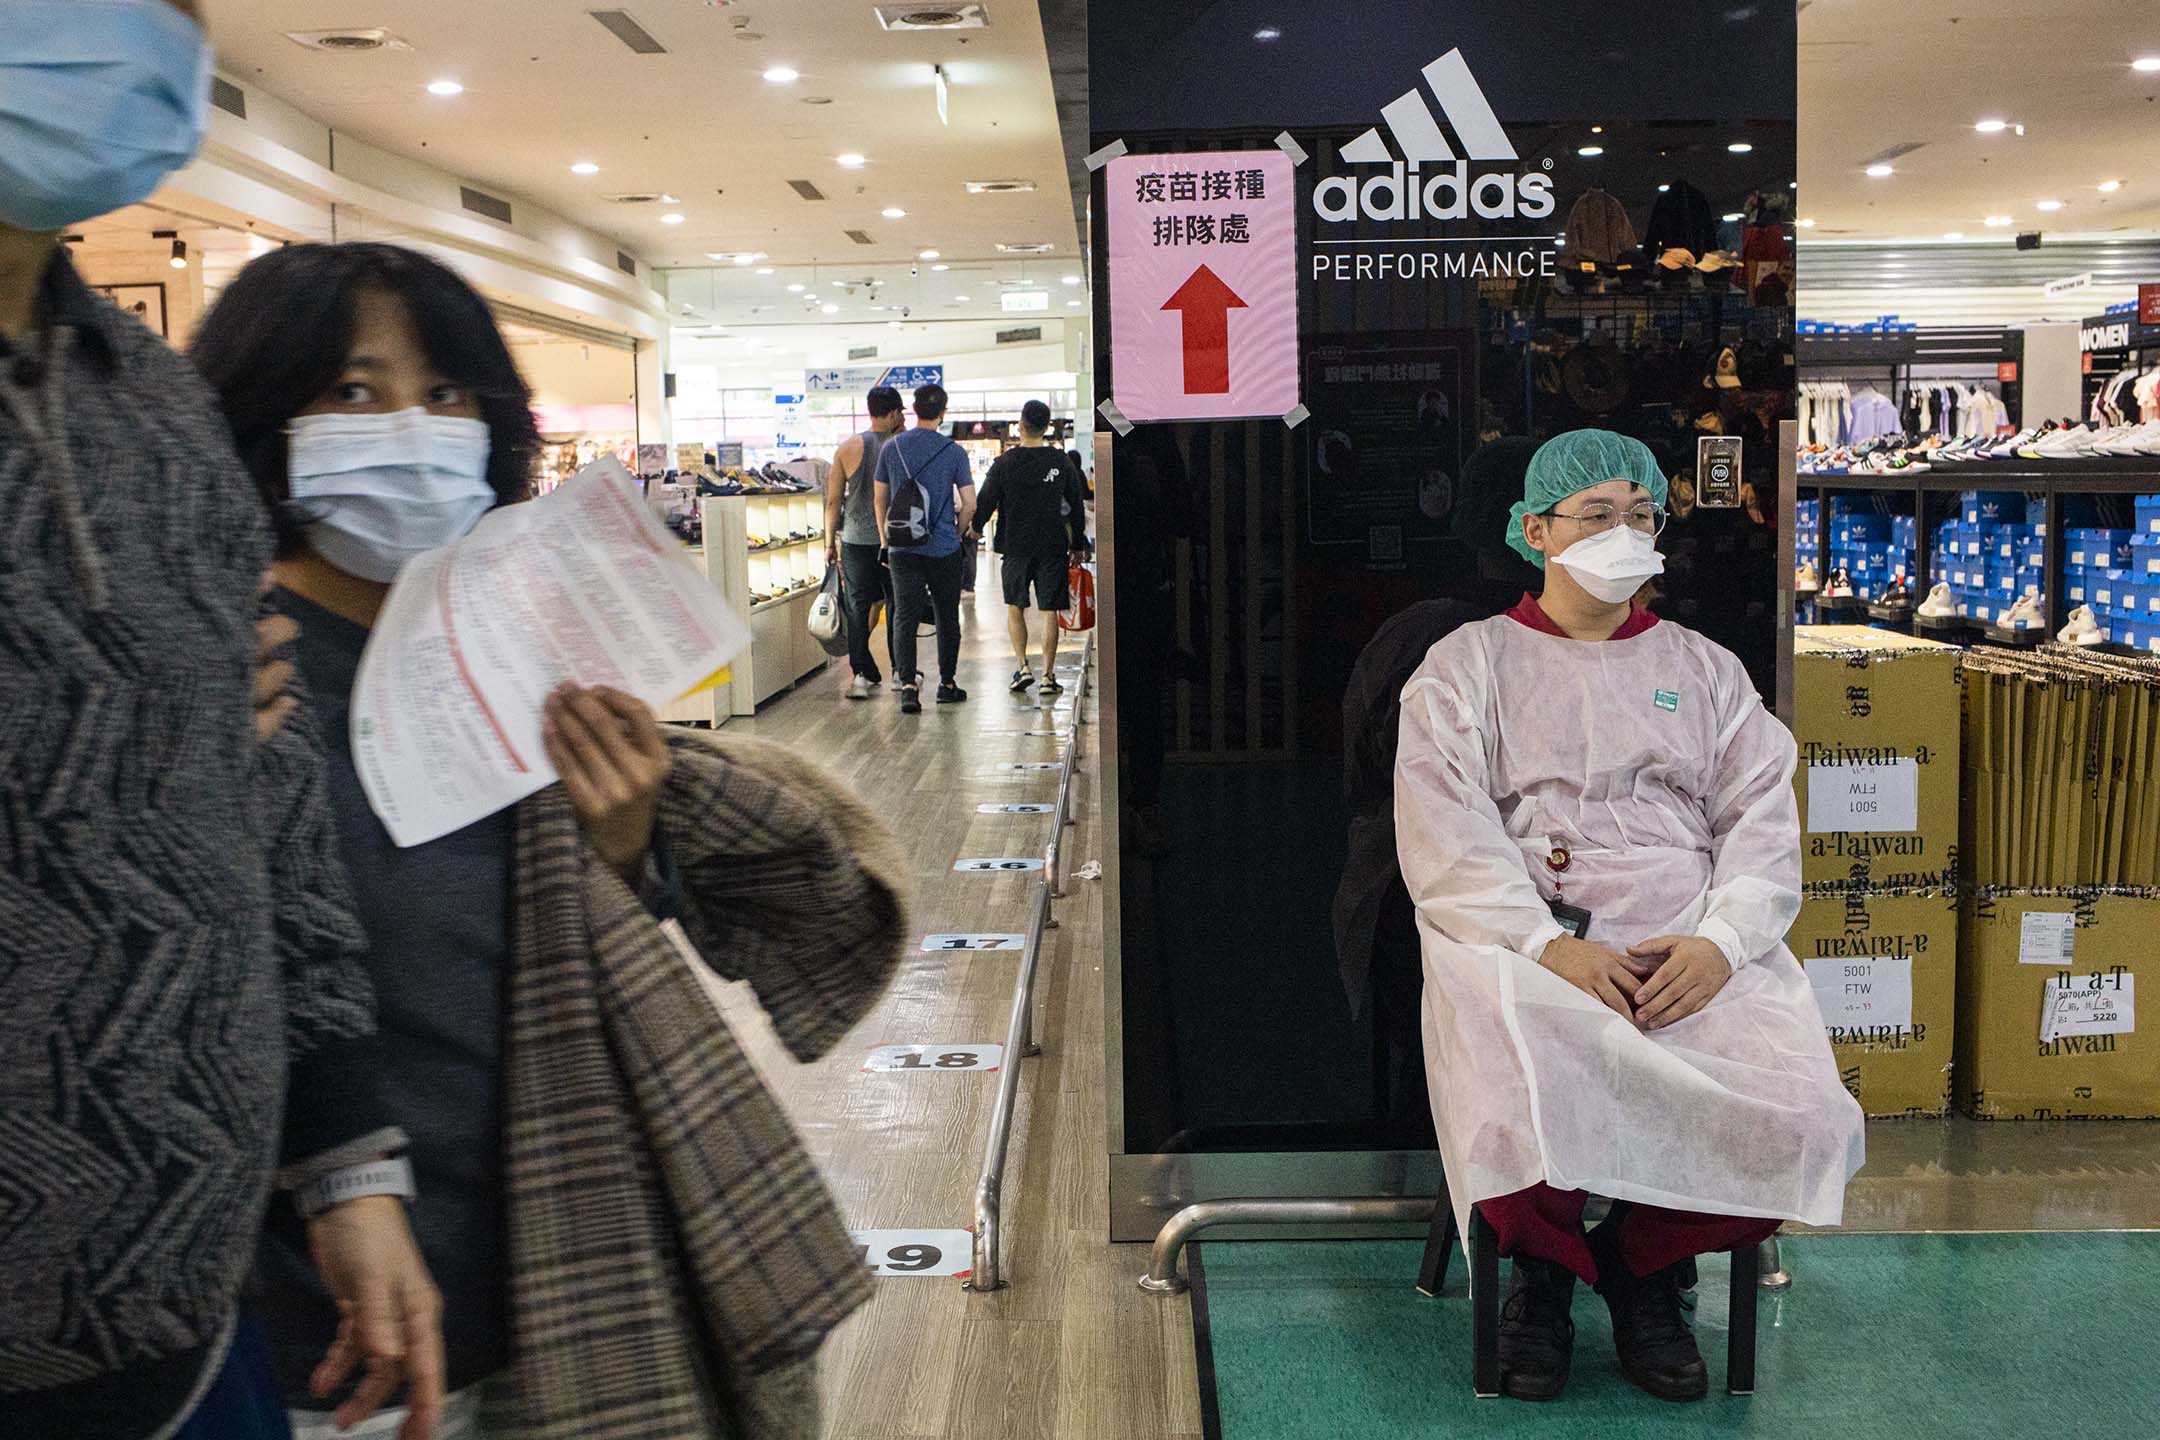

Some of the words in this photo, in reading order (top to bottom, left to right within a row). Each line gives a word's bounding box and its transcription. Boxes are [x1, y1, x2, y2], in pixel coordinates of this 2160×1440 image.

[1136, 169, 1265, 202] 疫苗接種
[1313, 159, 1556, 222] adidas
[1153, 213, 1250, 246] 排隊處
[1313, 251, 1556, 280] PERFORMANCE
[2079, 323, 2129, 352] WOMEN
[1849, 783, 1876, 795] FTW
[1850, 801, 1877, 812] 5001
[1811, 831, 1924, 857] a-Taiwan
[970, 862, 1028, 870] 16
[942, 939, 1009, 949] 17
[1815, 934, 1928, 961] a-Taiwan
[1844, 965, 1871, 977] 5001
[1845, 983, 1872, 995] FTW
[2093, 1013, 2118, 1022] 5220
[1826, 1024, 1927, 1050] a-Taiwa
[890, 1052, 979, 1068] 18
